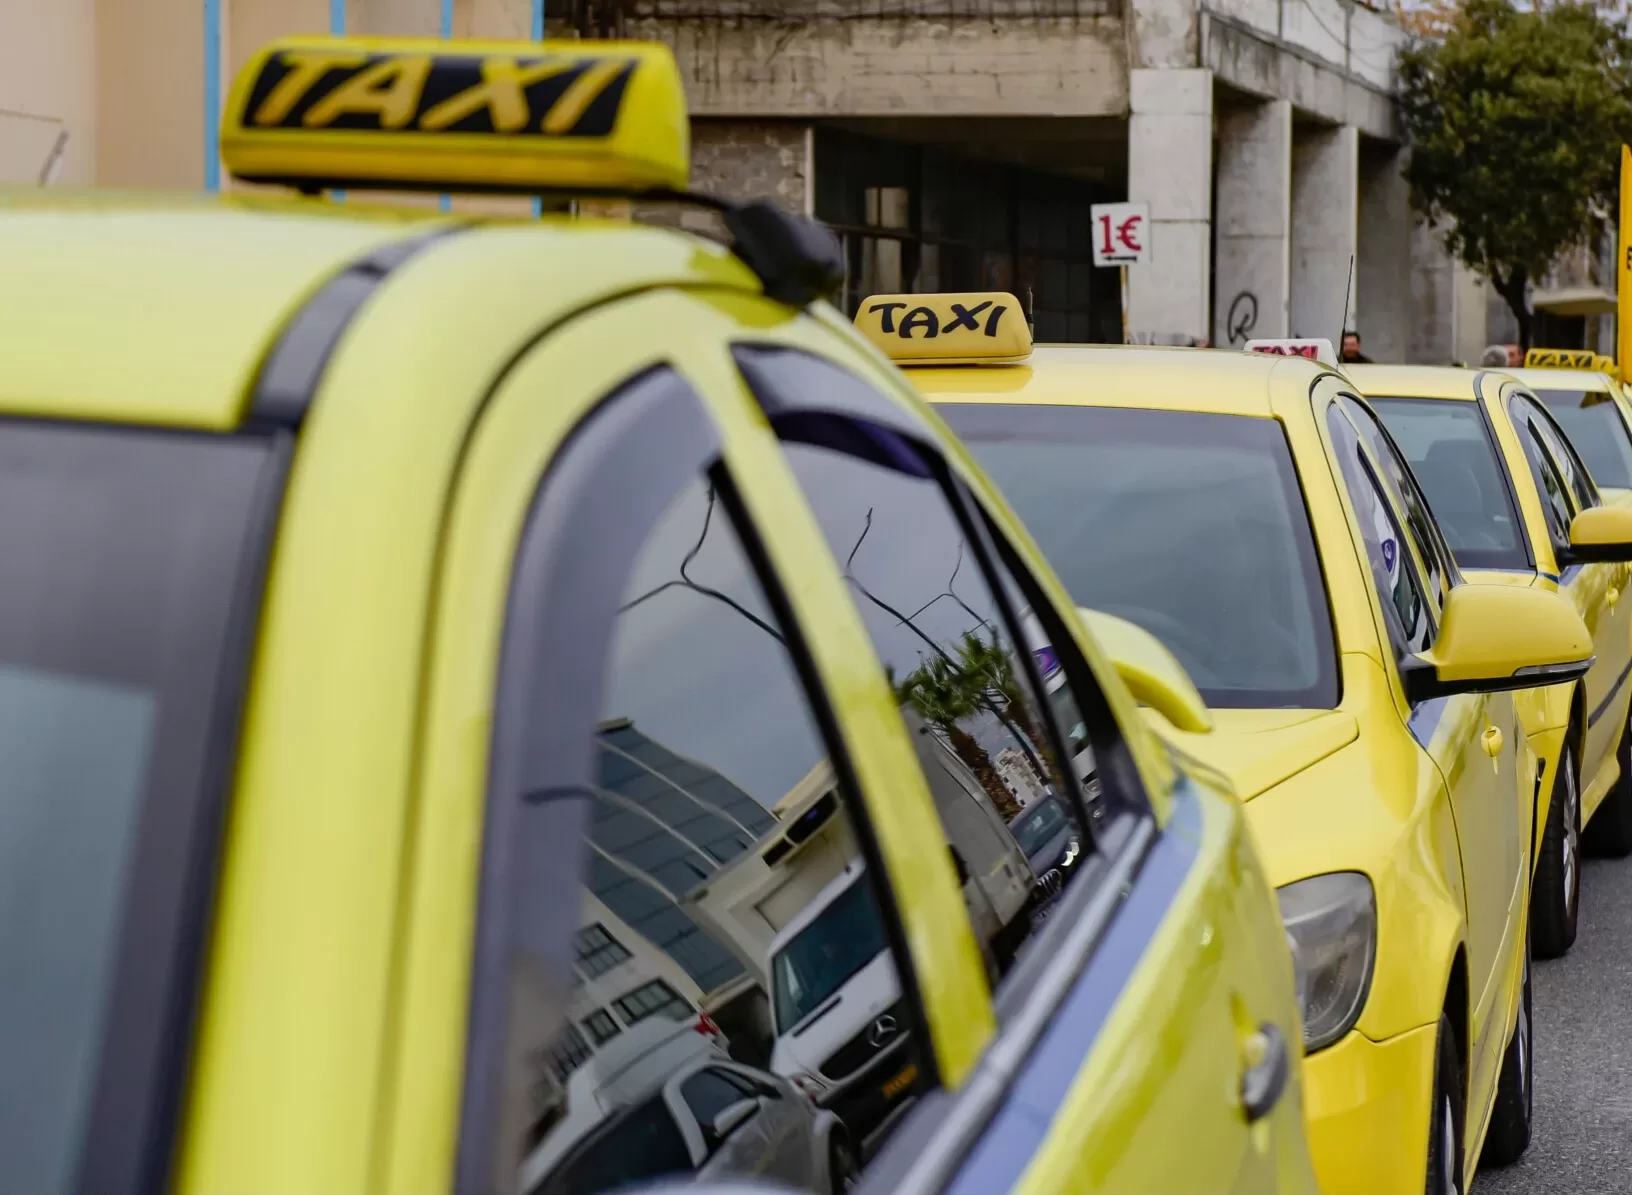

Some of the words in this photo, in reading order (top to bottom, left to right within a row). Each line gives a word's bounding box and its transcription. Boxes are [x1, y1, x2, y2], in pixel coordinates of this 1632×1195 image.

[253, 53, 631, 133] TAXI
[1099, 214, 1142, 254] 1€
[868, 301, 1007, 339] TAXI
